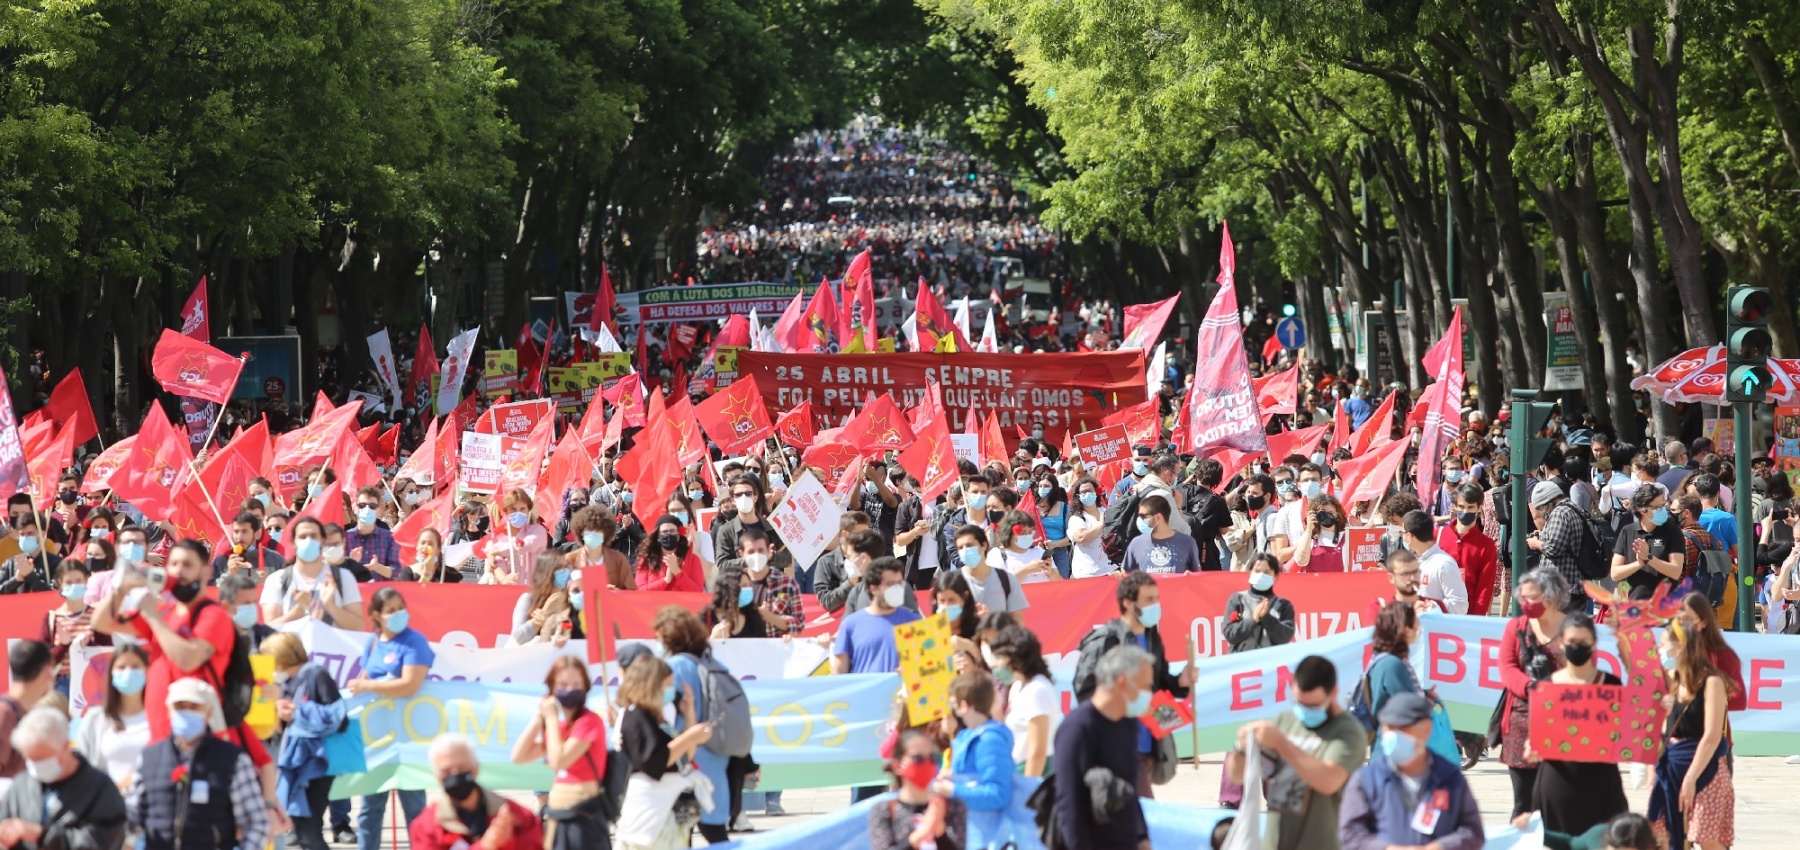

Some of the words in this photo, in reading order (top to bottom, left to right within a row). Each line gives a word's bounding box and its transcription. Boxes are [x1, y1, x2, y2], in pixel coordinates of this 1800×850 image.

[646, 290, 670, 302] COM
[683, 288, 709, 300] LUTA
[712, 287, 733, 299] DOS
[667, 304, 703, 317] DEFESA
[706, 303, 726, 315] DOS
[729, 300, 774, 314] VALORES
[775, 365, 804, 381] 25
[821, 366, 895, 383] ABRIL
[925, 365, 1013, 388] SEMPRE
[778, 387, 813, 406] FOI
[887, 388, 926, 408] LUT
[1015, 387, 1084, 407] FOMOS
[465, 445, 488, 453] CONTRA
[463, 468, 478, 476] PELA
[1191, 612, 1362, 658] ORNIZA
[361, 695, 509, 748] COM
